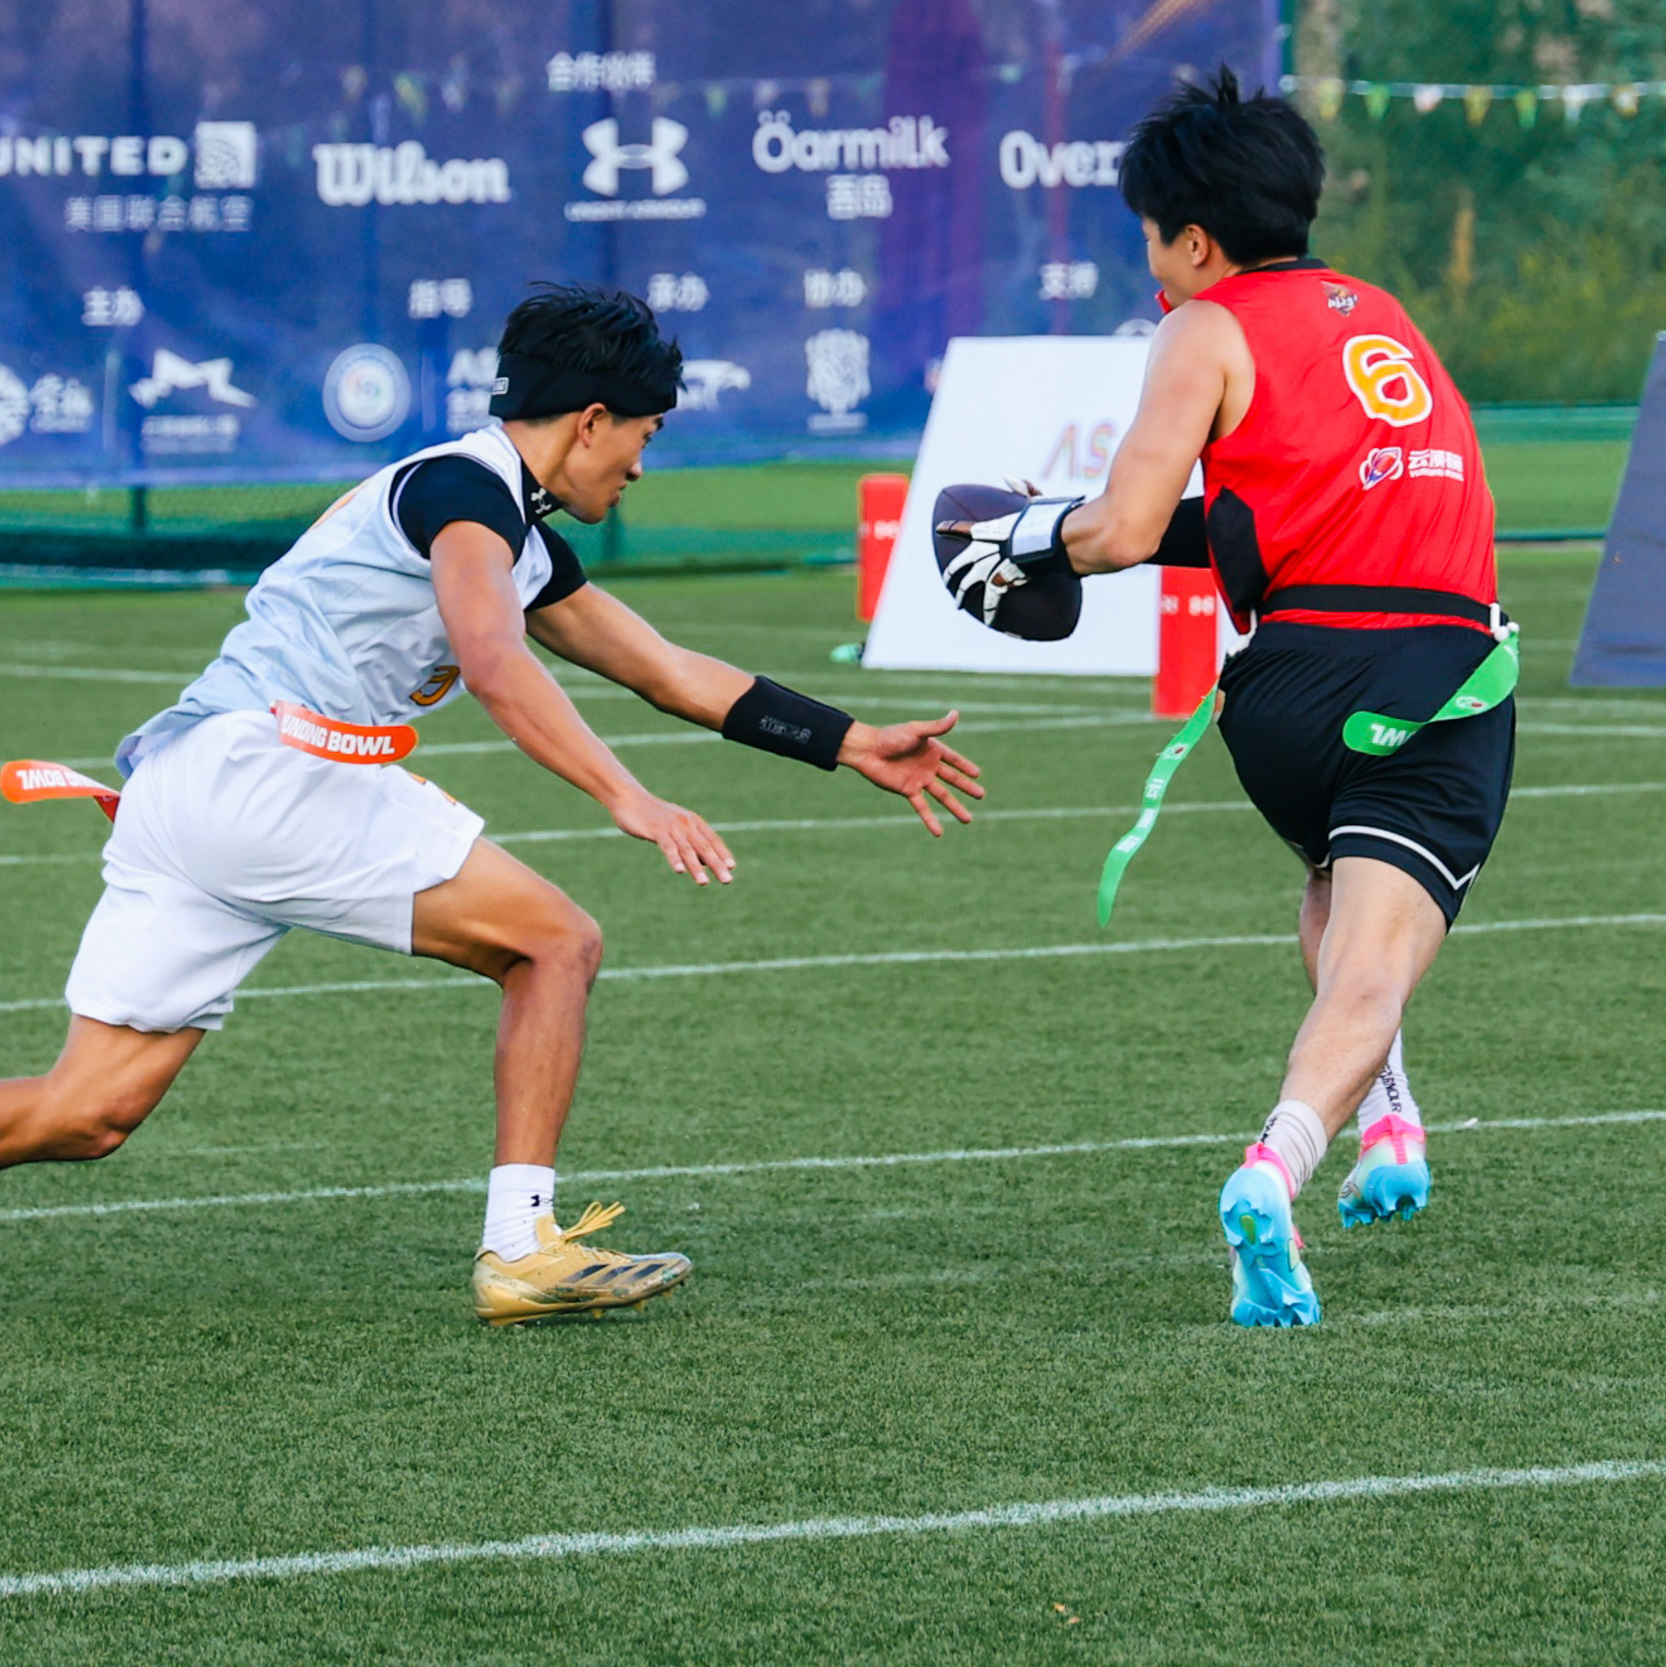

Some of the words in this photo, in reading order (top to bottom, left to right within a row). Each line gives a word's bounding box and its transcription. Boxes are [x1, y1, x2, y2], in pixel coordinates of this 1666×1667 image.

[312, 140, 511, 206] Wilson
[1342, 334, 1433, 427] 6
[327, 730, 396, 756] BOWL
